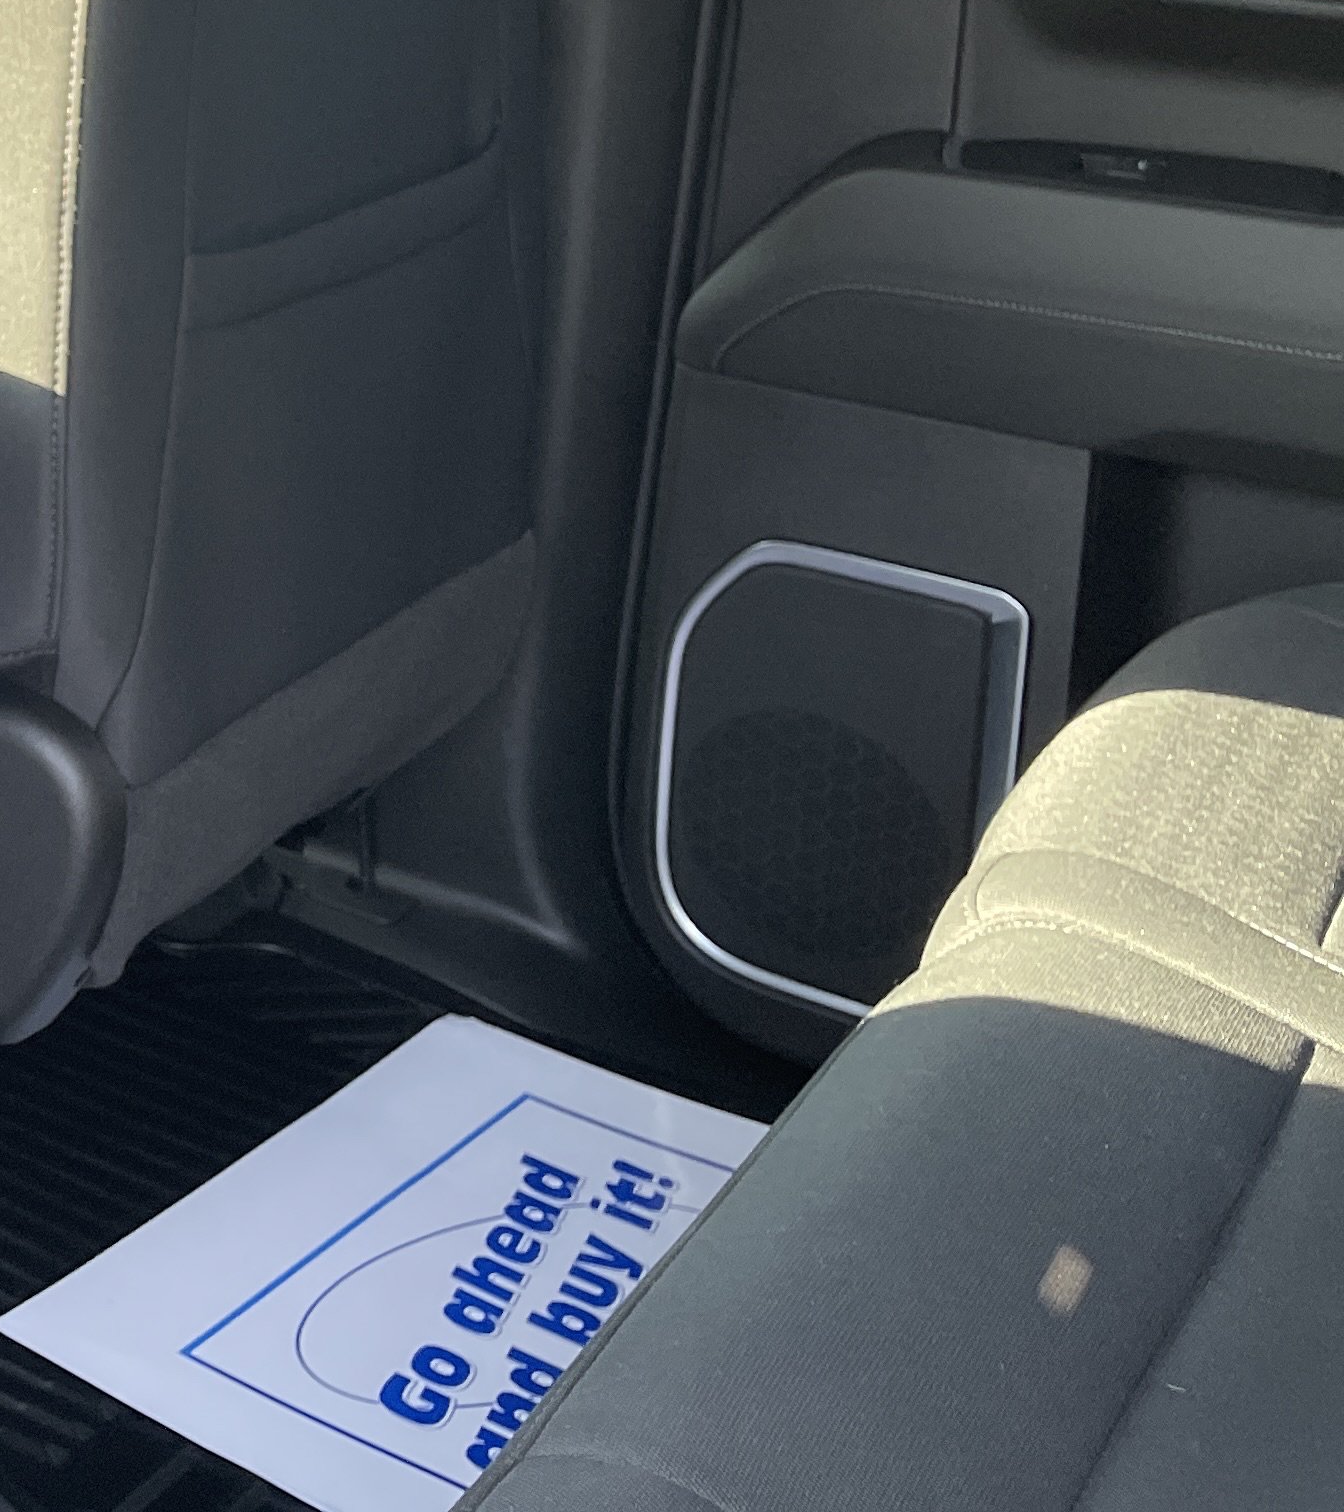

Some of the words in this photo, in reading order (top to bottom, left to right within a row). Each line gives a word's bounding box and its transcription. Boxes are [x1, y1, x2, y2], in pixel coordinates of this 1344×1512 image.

[379, 1345, 471, 1424] Go
[443, 1153, 581, 1334] ahead
[466, 1346, 565, 1470] and
[527, 1234, 644, 1346] buy
[590, 1160, 674, 1230] it!
